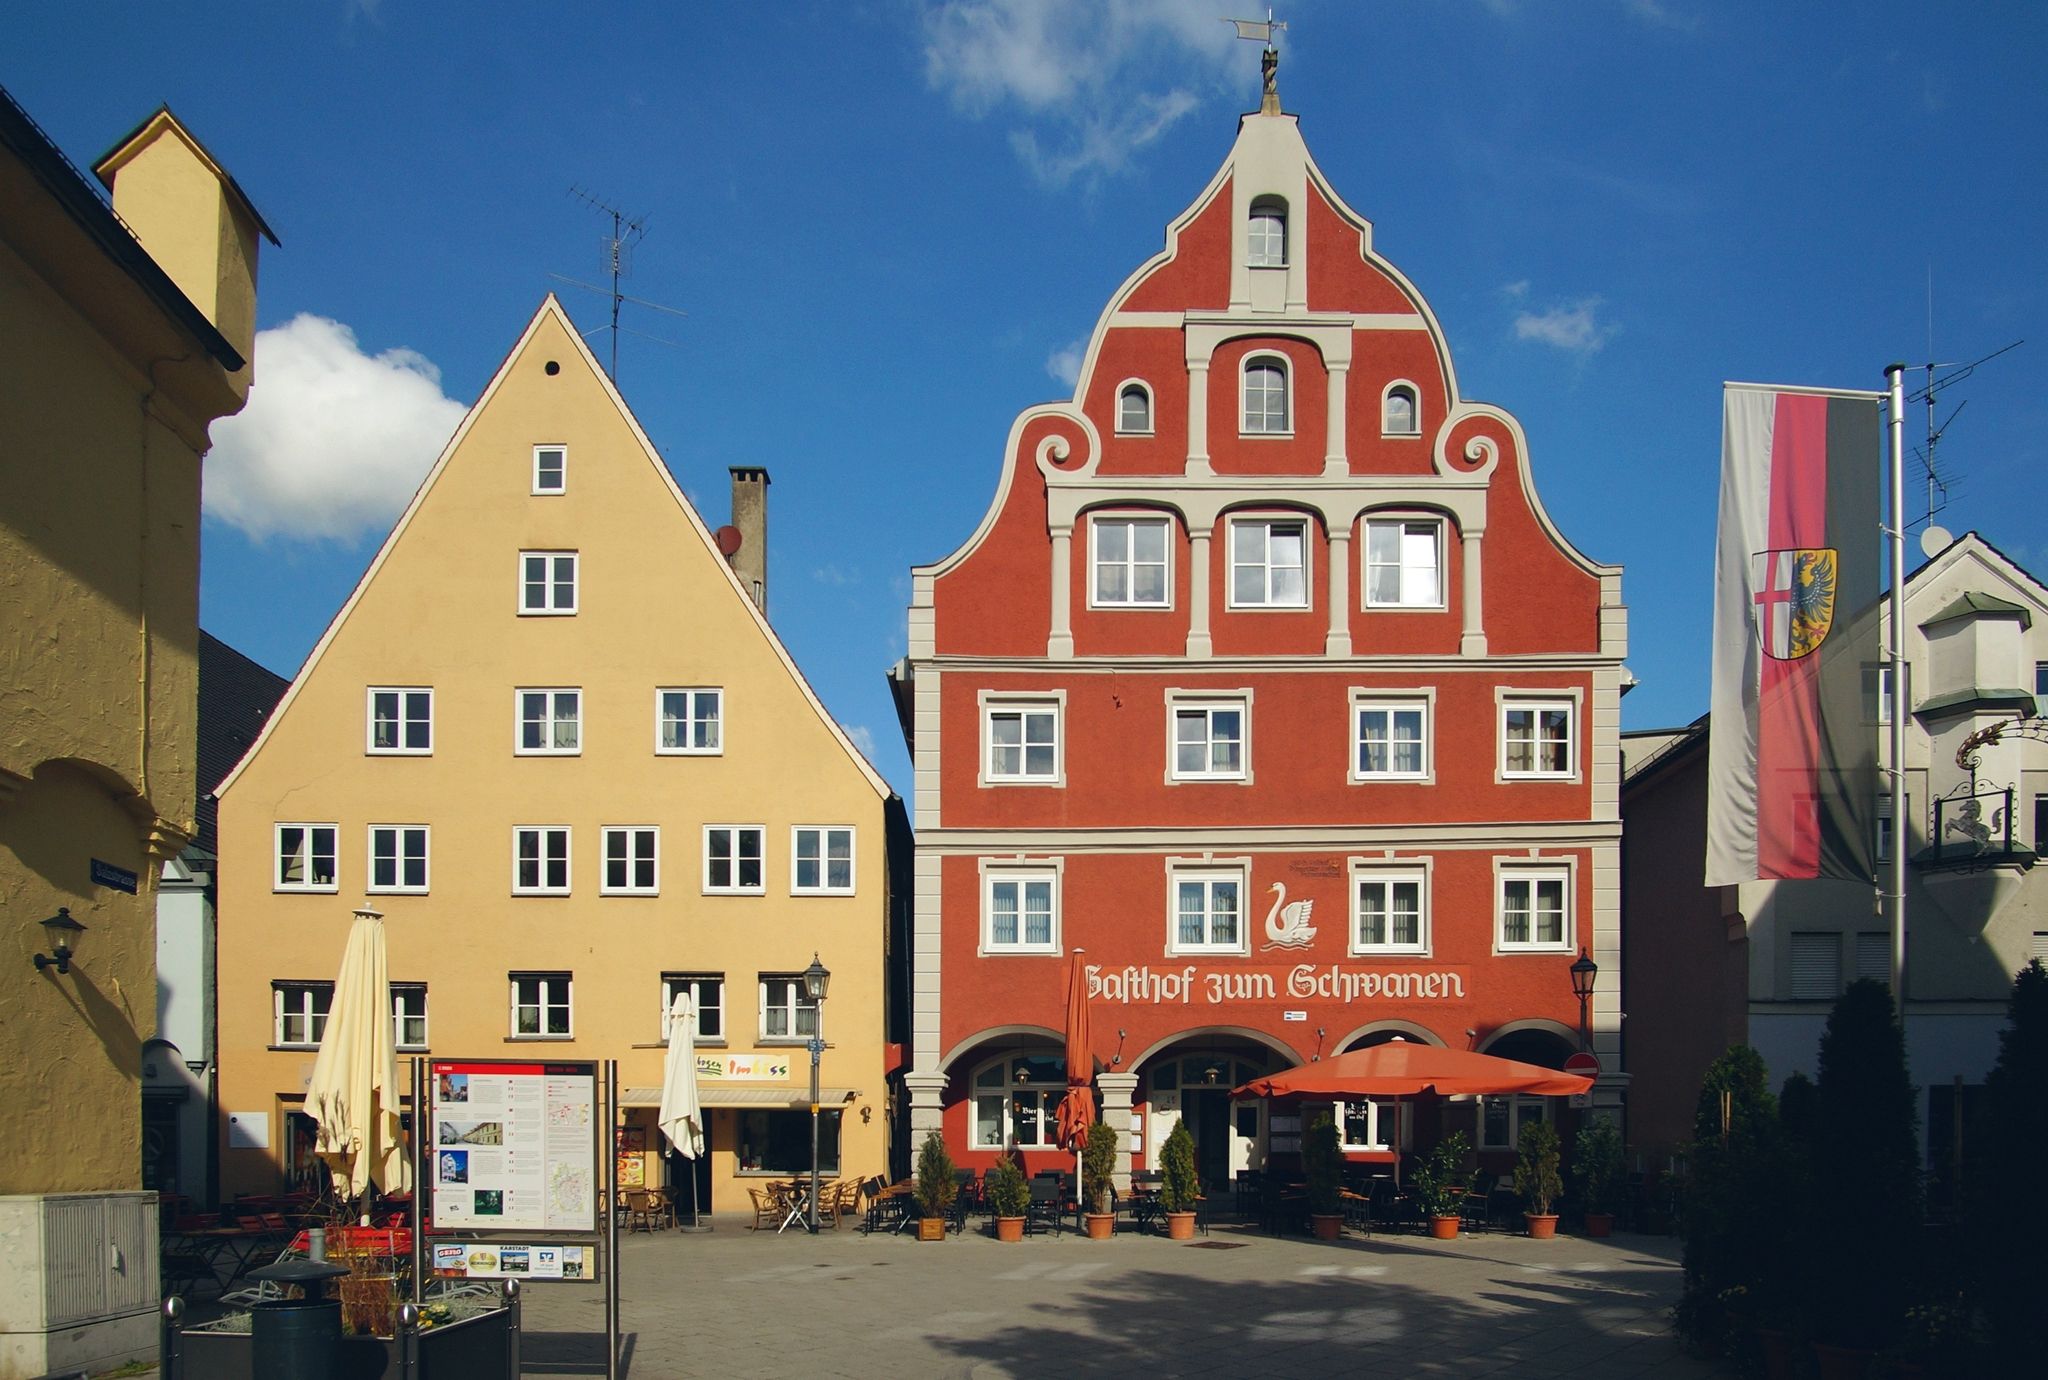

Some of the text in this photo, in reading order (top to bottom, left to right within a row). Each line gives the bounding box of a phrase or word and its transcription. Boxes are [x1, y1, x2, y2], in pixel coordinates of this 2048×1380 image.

[1203, 972, 1276, 1004] zum
[1286, 963, 1466, 1004] Schwanen
[729, 1059, 788, 1076] Imbiss
[1022, 1106, 1037, 1115] Bier
